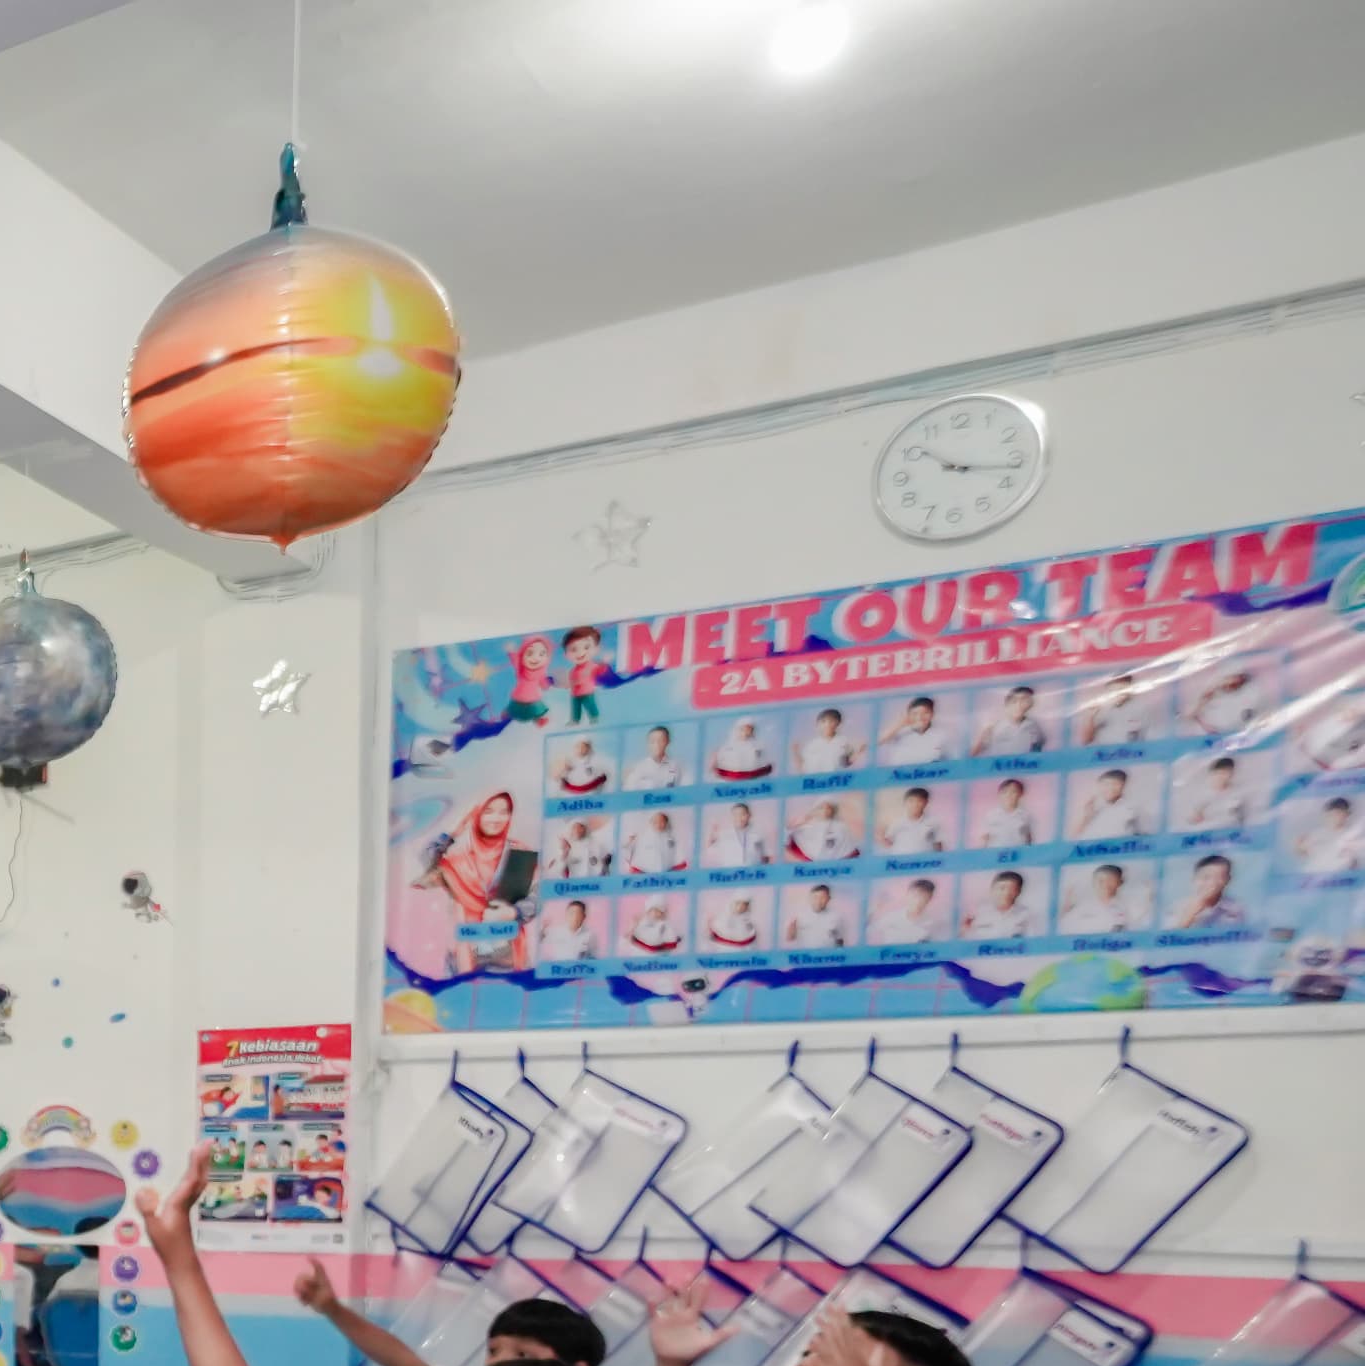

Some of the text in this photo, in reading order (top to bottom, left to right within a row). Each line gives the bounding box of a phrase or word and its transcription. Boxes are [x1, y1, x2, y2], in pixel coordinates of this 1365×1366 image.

[949, 412, 970, 430] 12
[984, 413, 992, 429] 1
[924, 423, 939, 440] 11
[1000, 426, 1018, 444] 2
[901, 446, 923, 462] 10
[1007, 450, 1023, 469] 3
[892, 471, 909, 487] 9
[997, 475, 1013, 489] 4
[900, 491, 917, 508] 8
[974, 496, 992, 513] 5
[921, 504, 937, 521] 7
[945, 507, 963, 524] 6
[626, 522, 1319, 672] MEET OUR TEAM
[720, 618, 1172, 696] 2A BYTEBRILLIANCE
[226, 1039, 319, 1057] 7 Kebiasaan
